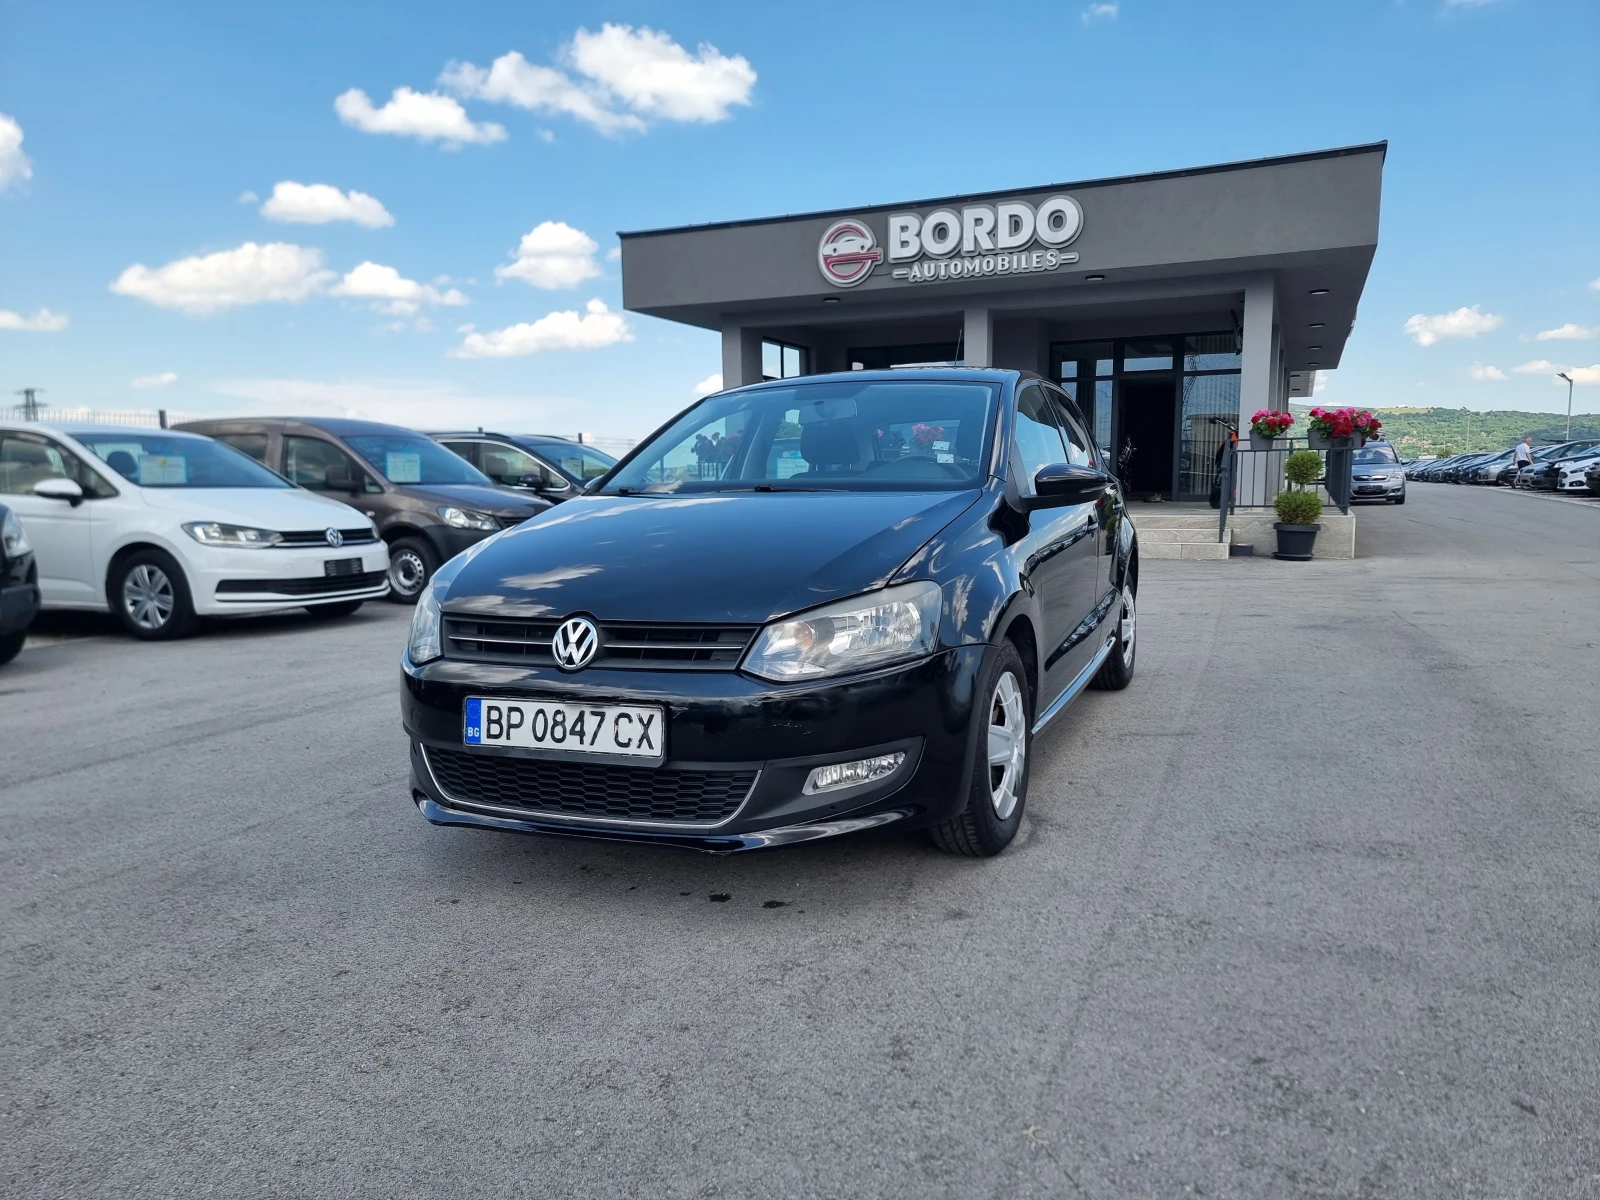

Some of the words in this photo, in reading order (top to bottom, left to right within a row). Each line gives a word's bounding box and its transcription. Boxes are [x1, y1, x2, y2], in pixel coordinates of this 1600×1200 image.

[889, 197, 1081, 260] BORDO
[910, 251, 1059, 278] AUTOMOBILES
[467, 726, 480, 738] BG
[486, 705, 525, 740] BP
[531, 708, 606, 746] 0847
[613, 712, 655, 750] CX
